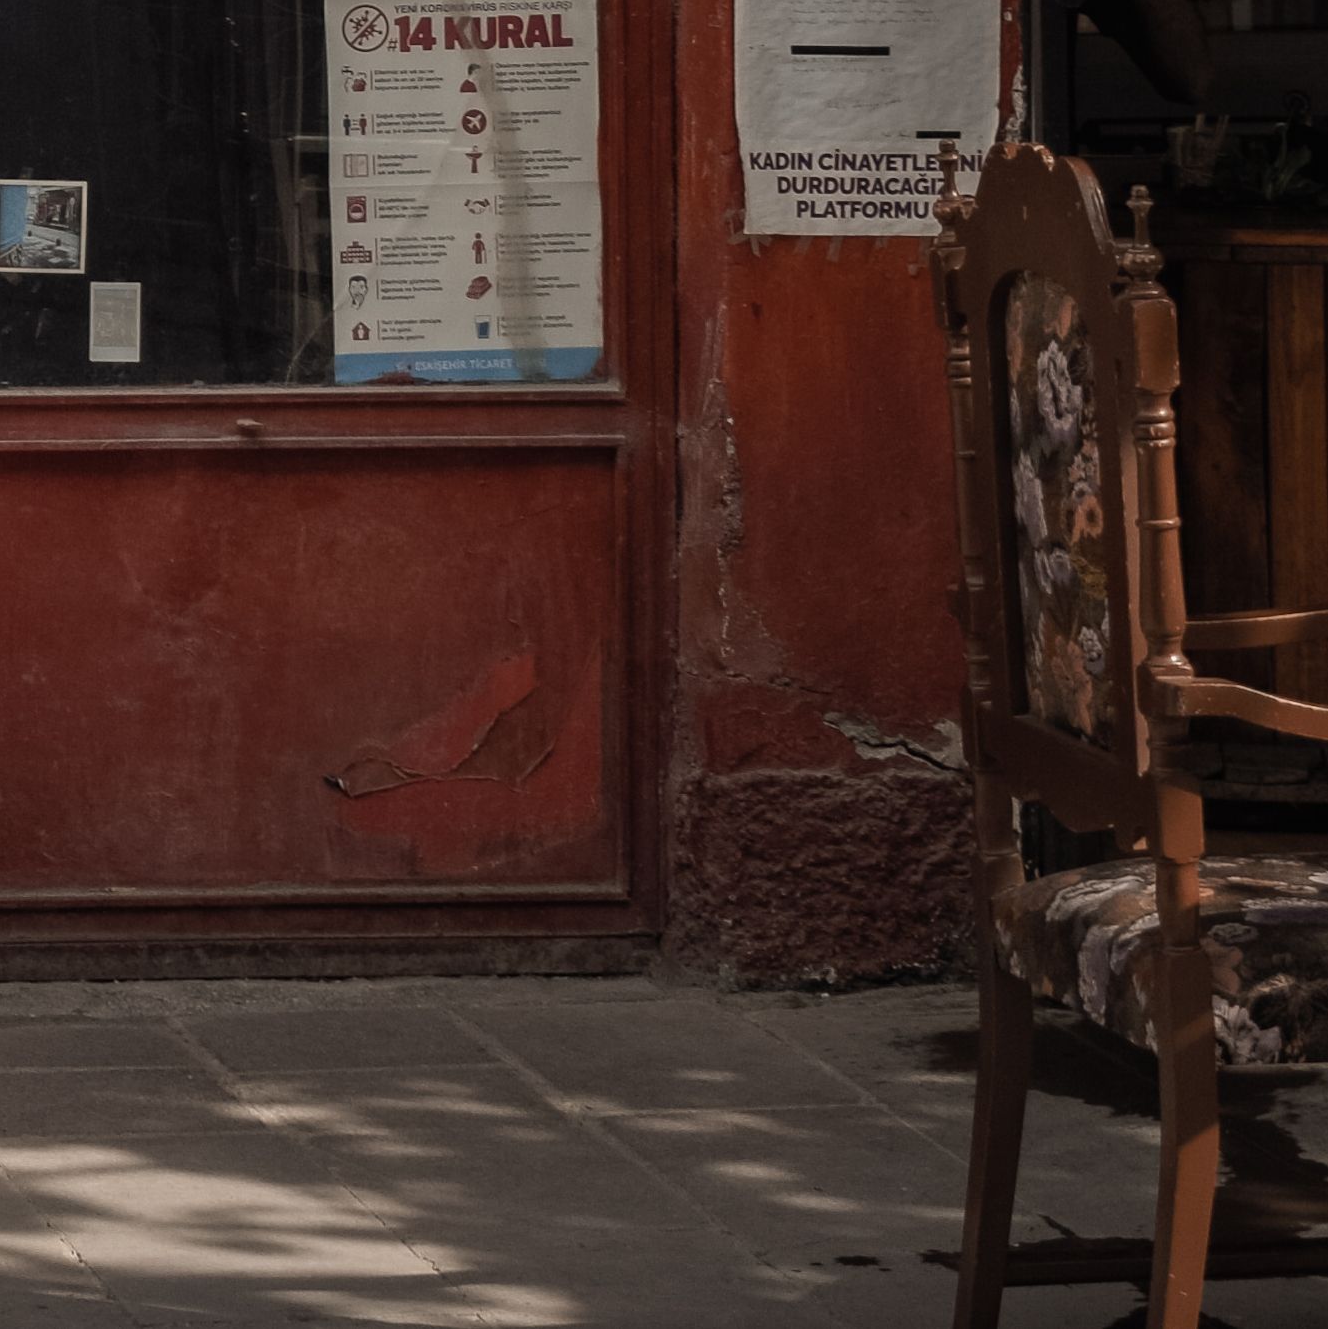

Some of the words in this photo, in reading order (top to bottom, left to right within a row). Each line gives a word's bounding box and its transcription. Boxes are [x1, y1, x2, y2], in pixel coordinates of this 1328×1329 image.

[394, 3, 418, 14] YENİ
[387, 15, 436, 53] #14
[444, 14, 574, 50] KURAL
[749, 152, 813, 171] KADIN
[795, 201, 929, 219] PLATFORMU
